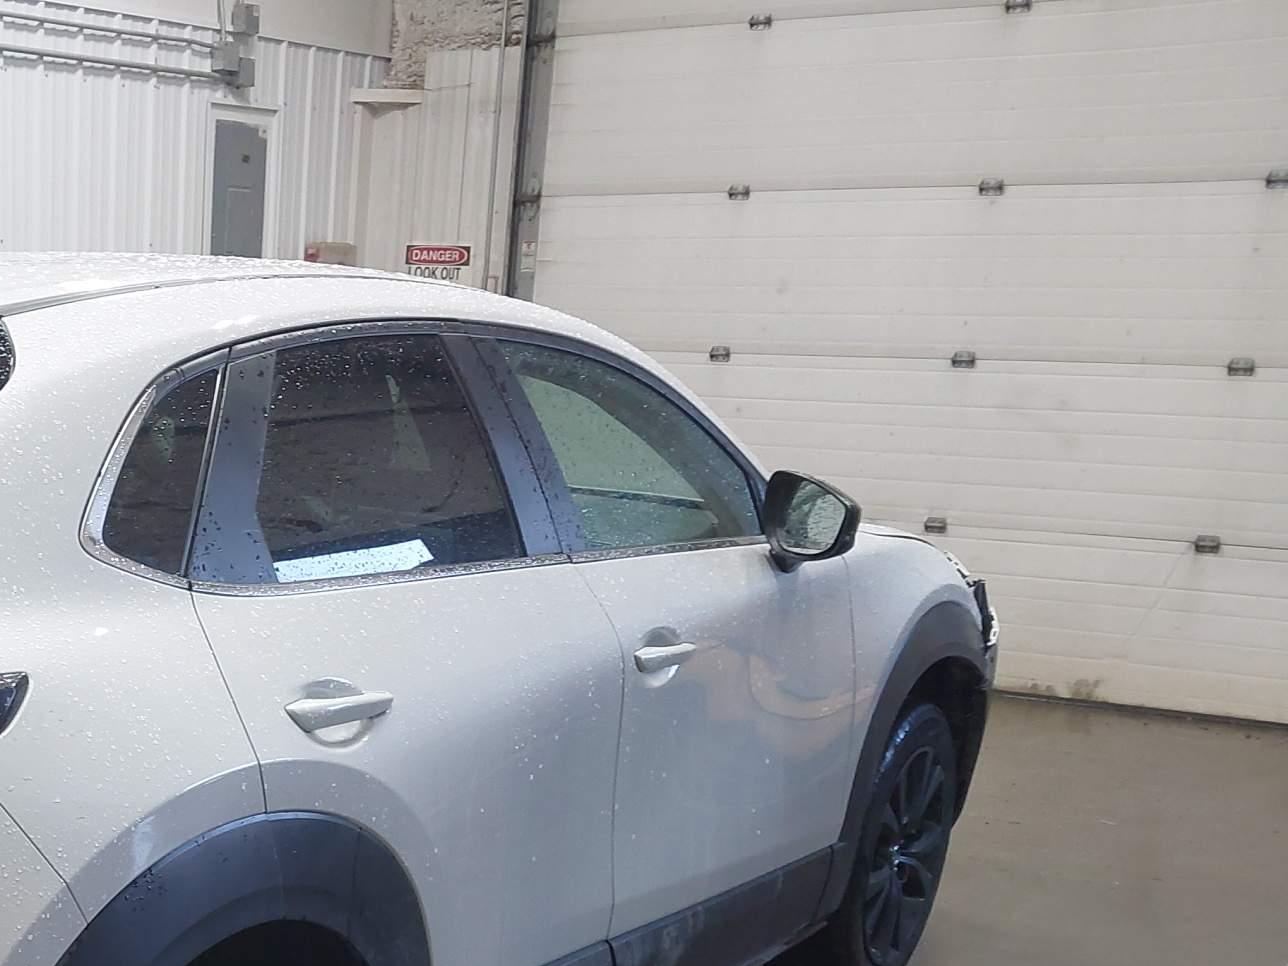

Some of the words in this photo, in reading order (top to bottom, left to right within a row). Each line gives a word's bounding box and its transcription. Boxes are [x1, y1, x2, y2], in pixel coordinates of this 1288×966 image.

[412, 250, 459, 261] DANGER
[408, 266, 439, 280] LOOK
[440, 267, 461, 280] OUT
